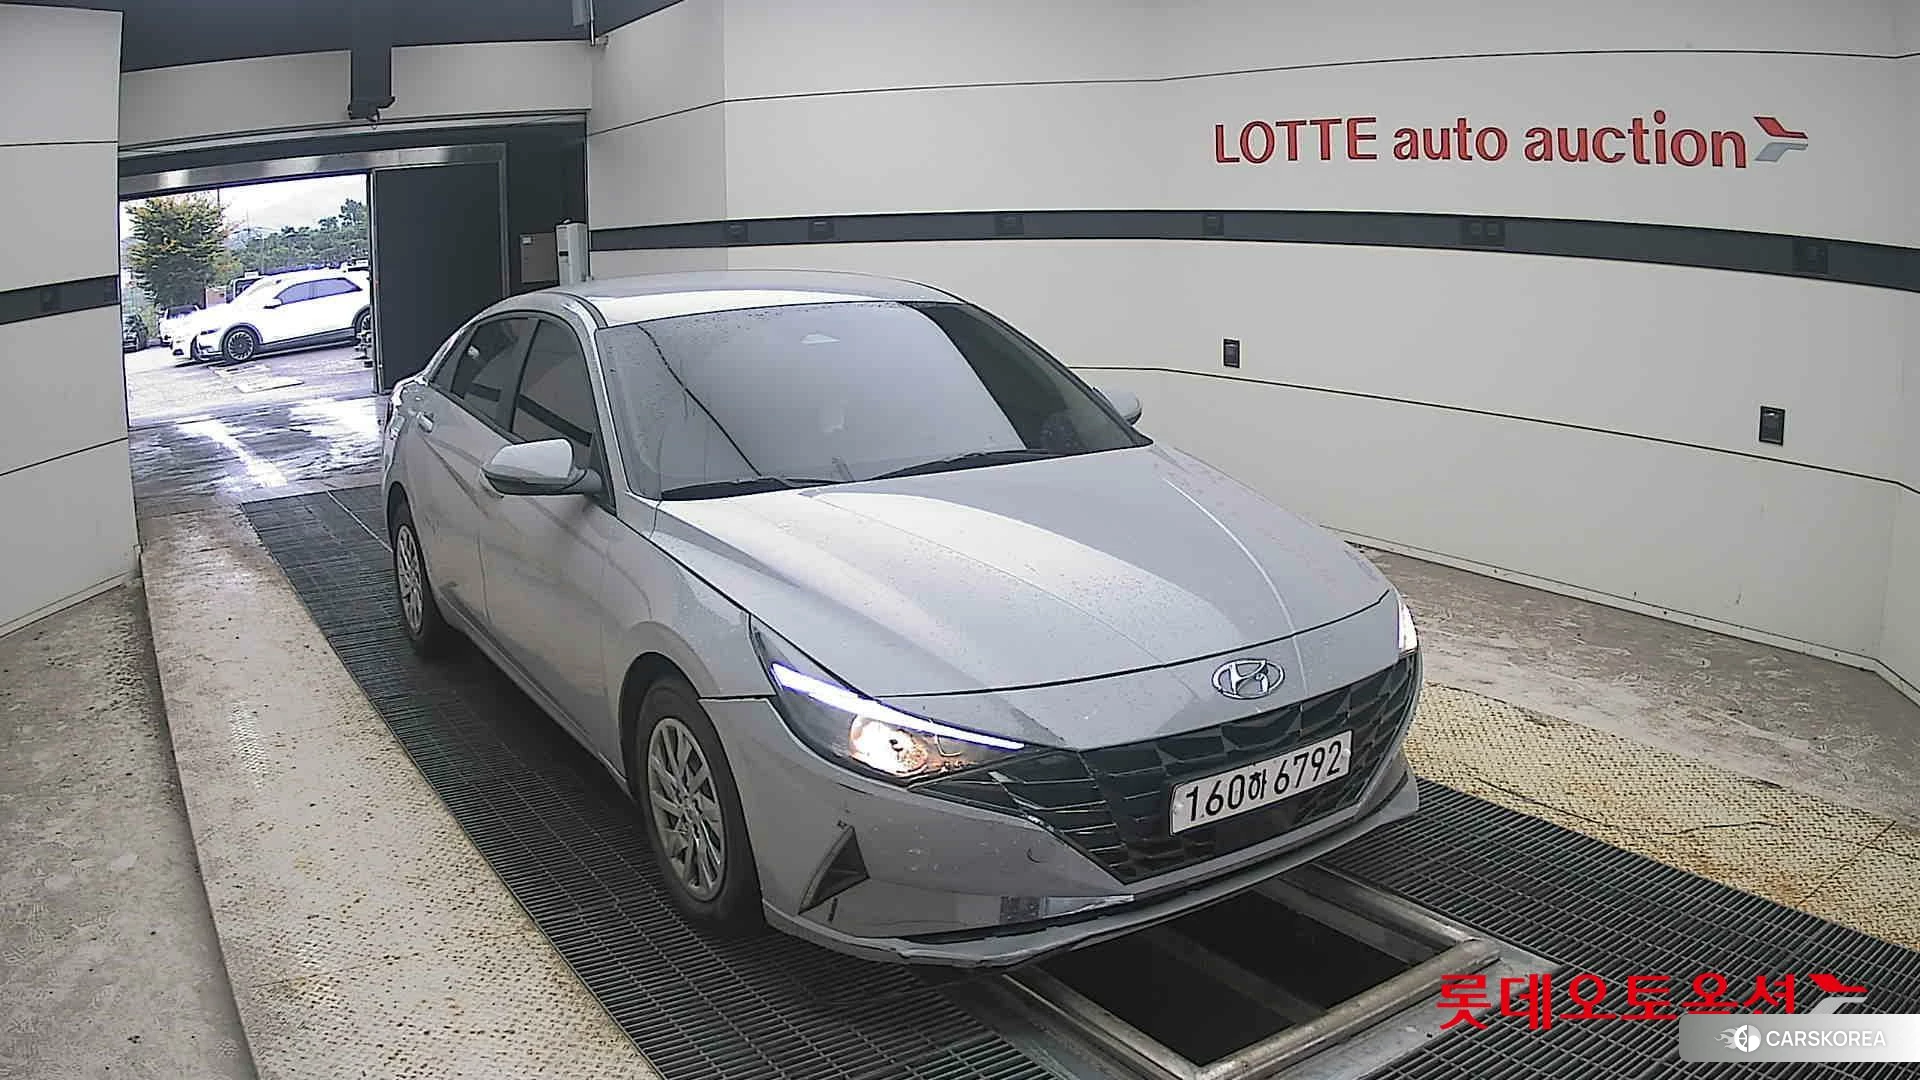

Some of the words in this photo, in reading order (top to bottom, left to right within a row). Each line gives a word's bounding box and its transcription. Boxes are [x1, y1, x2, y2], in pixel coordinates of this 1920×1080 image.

[1215, 116, 1377, 164] LOTTE
[1393, 118, 1509, 162] auto
[1523, 110, 1748, 169] auction
